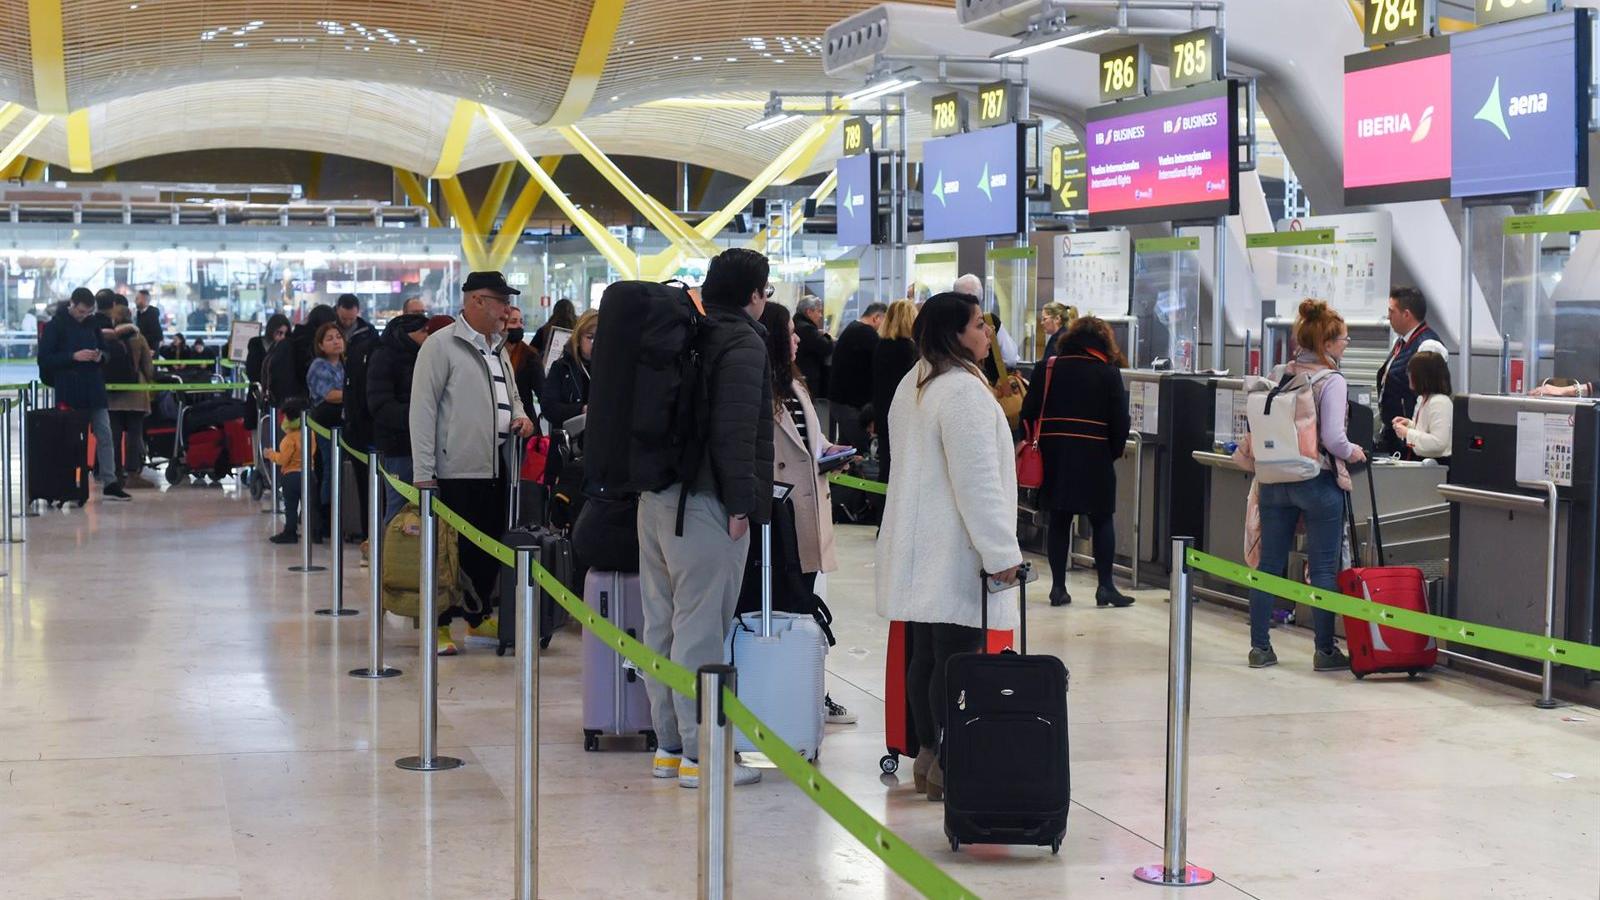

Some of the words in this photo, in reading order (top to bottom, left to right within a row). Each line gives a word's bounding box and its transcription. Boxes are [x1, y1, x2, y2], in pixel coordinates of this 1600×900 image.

[1370, 0, 1417, 34] 784
[1174, 39, 1206, 78] 785
[1103, 56, 1134, 92] 786
[934, 101, 956, 130] 788
[981, 89, 1004, 120] 787
[1508, 92, 1548, 117] aena
[1095, 132, 1105, 145] IB
[1113, 125, 1145, 142] BUSINESS
[1163, 120, 1173, 133] IB
[1182, 112, 1218, 130] BUSINESS
[1358, 113, 1412, 138] IBERIA
[845, 125, 861, 149] 789
[1091, 164, 1106, 176] Vuelos
[1158, 154, 1174, 166] Vuelos
[1174, 149, 1212, 164] Internacionales
[1187, 165, 1203, 179] flights
